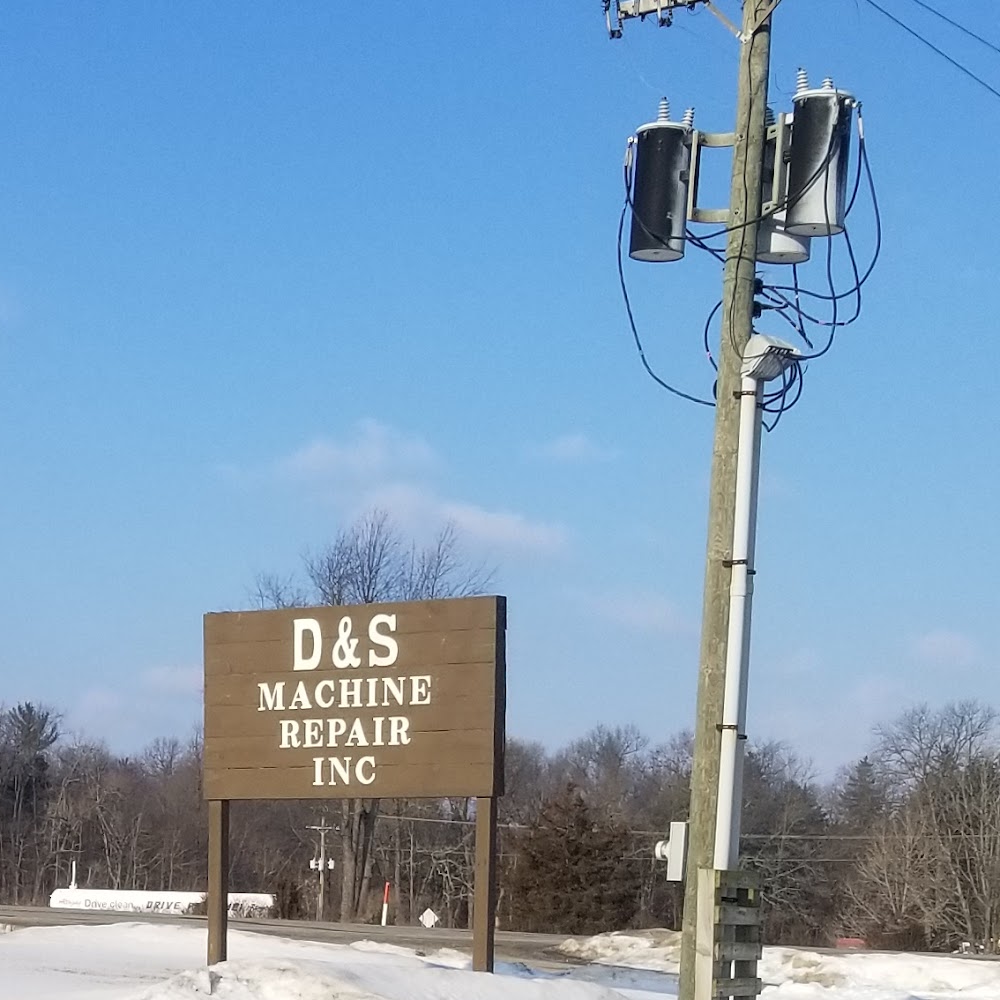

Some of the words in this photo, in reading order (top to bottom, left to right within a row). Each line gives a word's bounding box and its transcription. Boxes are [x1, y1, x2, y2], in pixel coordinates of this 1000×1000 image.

[257, 675, 432, 711] MACHINE
[279, 716, 412, 749] REPAIR
[312, 756, 376, 786] INC
[146, 901, 181, 910] DRIVE
